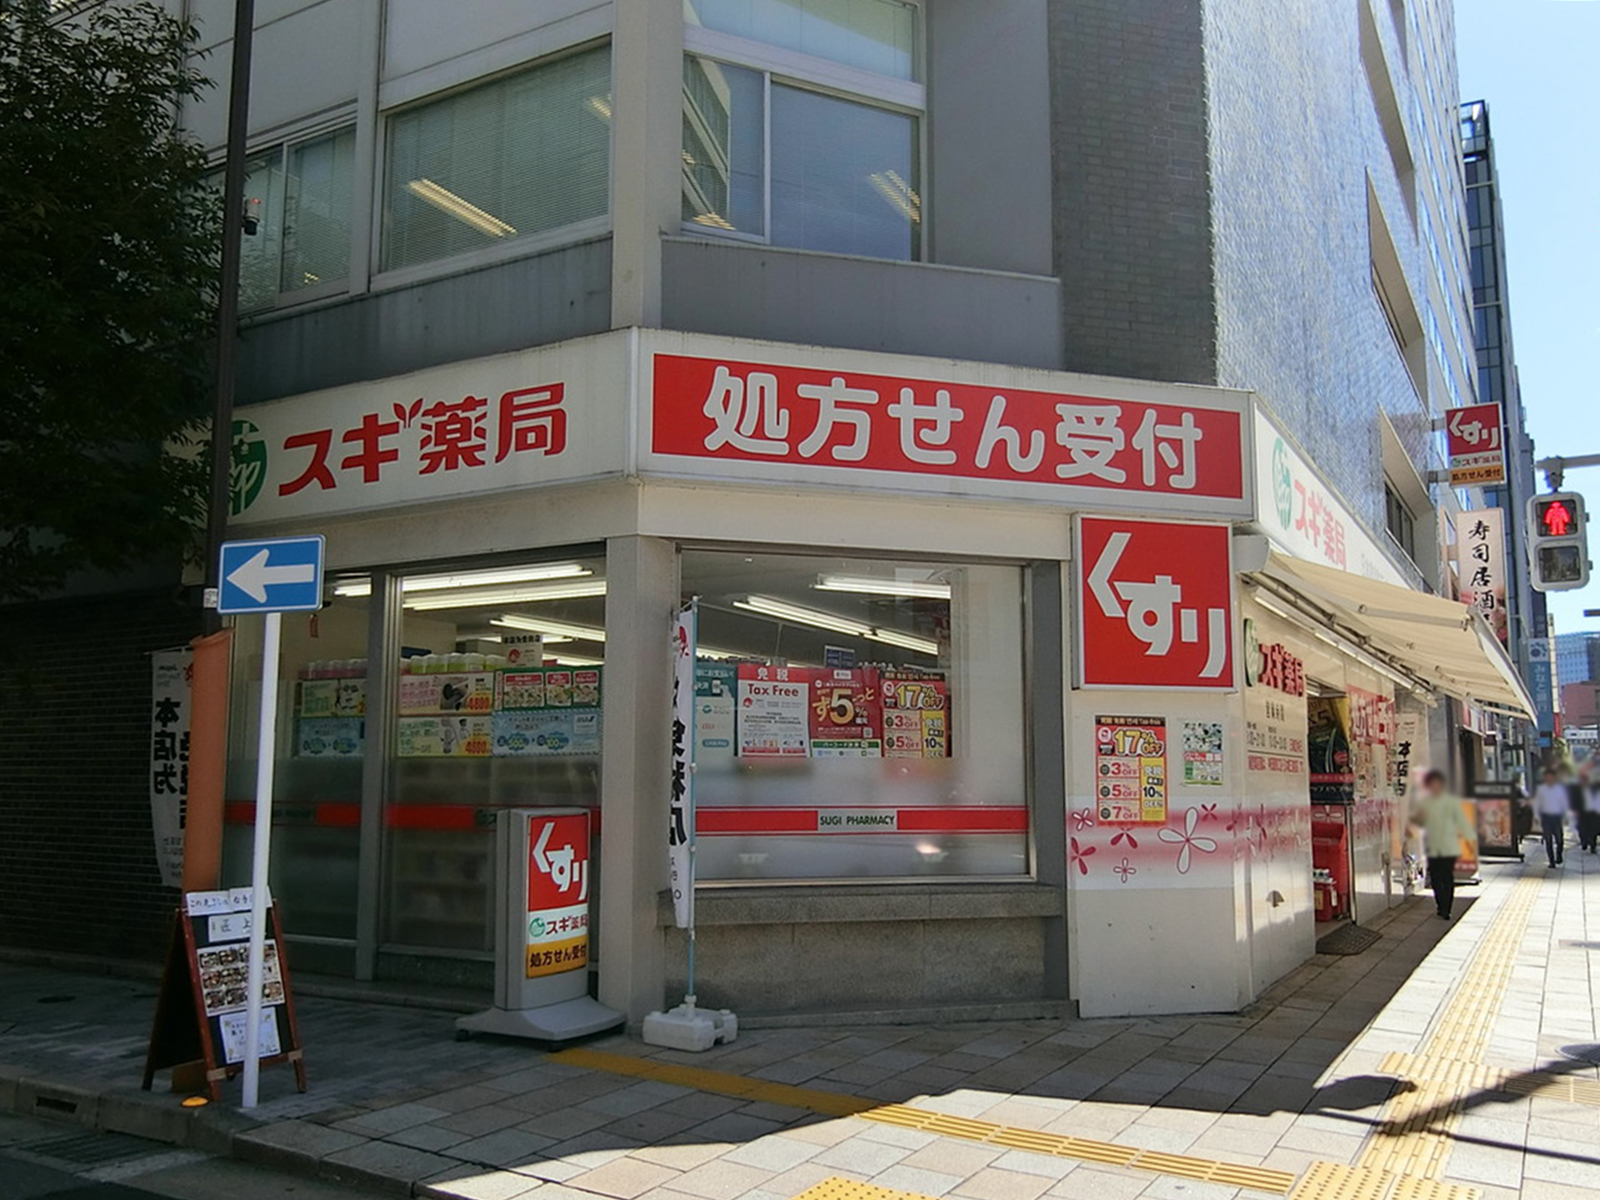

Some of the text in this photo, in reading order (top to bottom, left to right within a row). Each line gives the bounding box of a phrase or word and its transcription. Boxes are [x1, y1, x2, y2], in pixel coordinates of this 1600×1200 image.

[279, 382, 567, 496] スギ薬局
[703, 366, 1203, 490] 処方せん受付
[1449, 411, 1499, 449] くすり
[1294, 479, 1346, 572] スギ薬局
[1468, 519, 1495, 626] 寿司居酒
[1087, 532, 1226, 678] くすり
[748, 683, 799, 697] Tax Free
[1114, 730, 1154, 753] 17%
[820, 815, 895, 826] SUGI PHARMACY
[533, 822, 587, 900] くすり
[546, 914, 588, 935] スギ薬局
[530, 944, 587, 968] 処方せん受付
